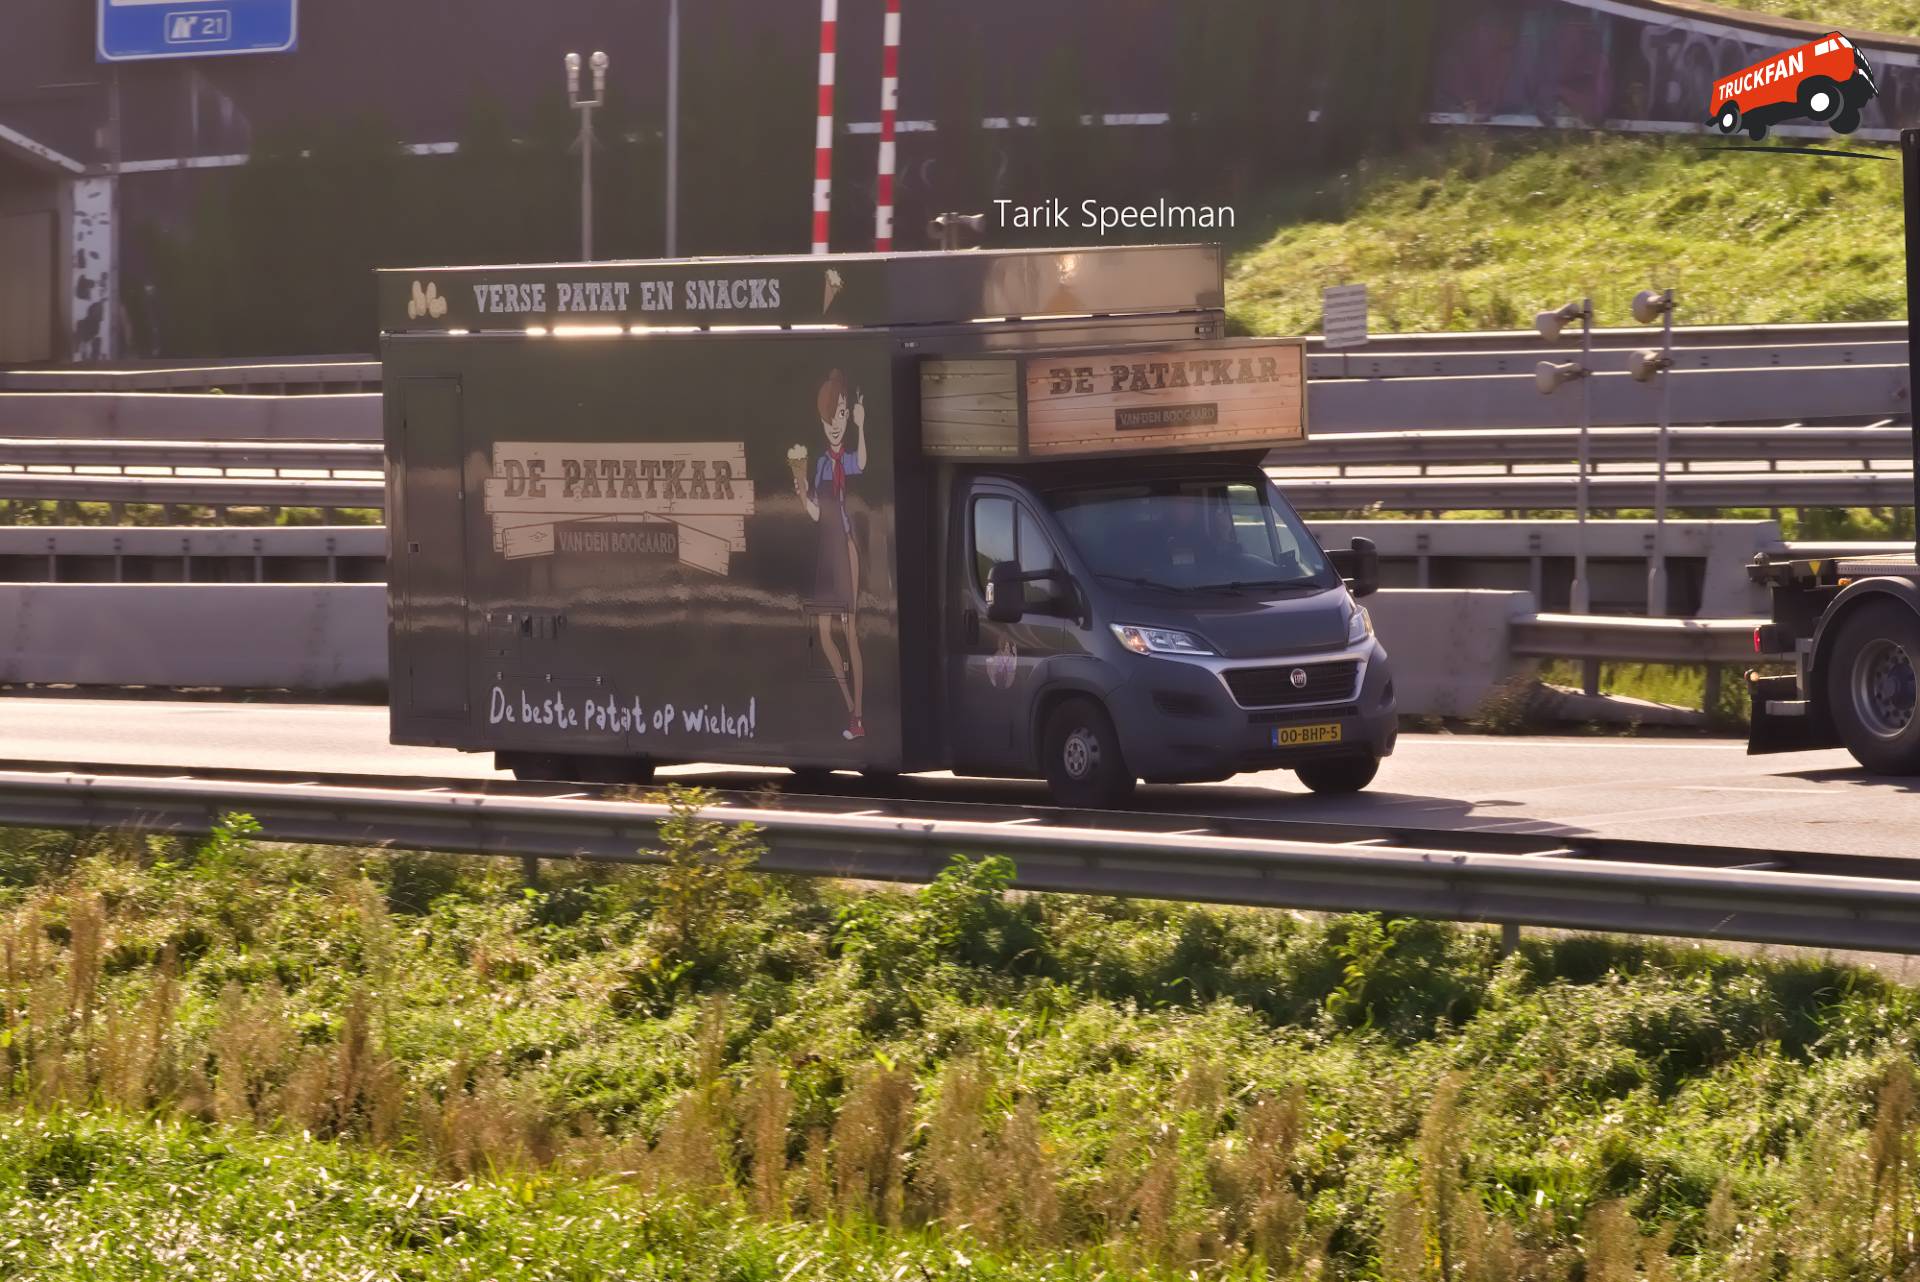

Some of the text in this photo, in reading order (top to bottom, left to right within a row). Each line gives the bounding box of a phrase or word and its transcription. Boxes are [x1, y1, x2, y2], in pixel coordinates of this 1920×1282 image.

[202, 18, 224, 34] 21
[473, 278, 781, 313] VERSE PATAT EN SNACKS
[1050, 357, 1280, 395] DE PATATKAR
[503, 459, 735, 500] DE PATATKAR
[559, 531, 677, 553] VAN DEN BOOGAARD
[490, 686, 516, 724] De
[522, 689, 578, 729] beste
[682, 696, 757, 739] wielen!
[1281, 726, 1338, 743] 00-BHP-5
